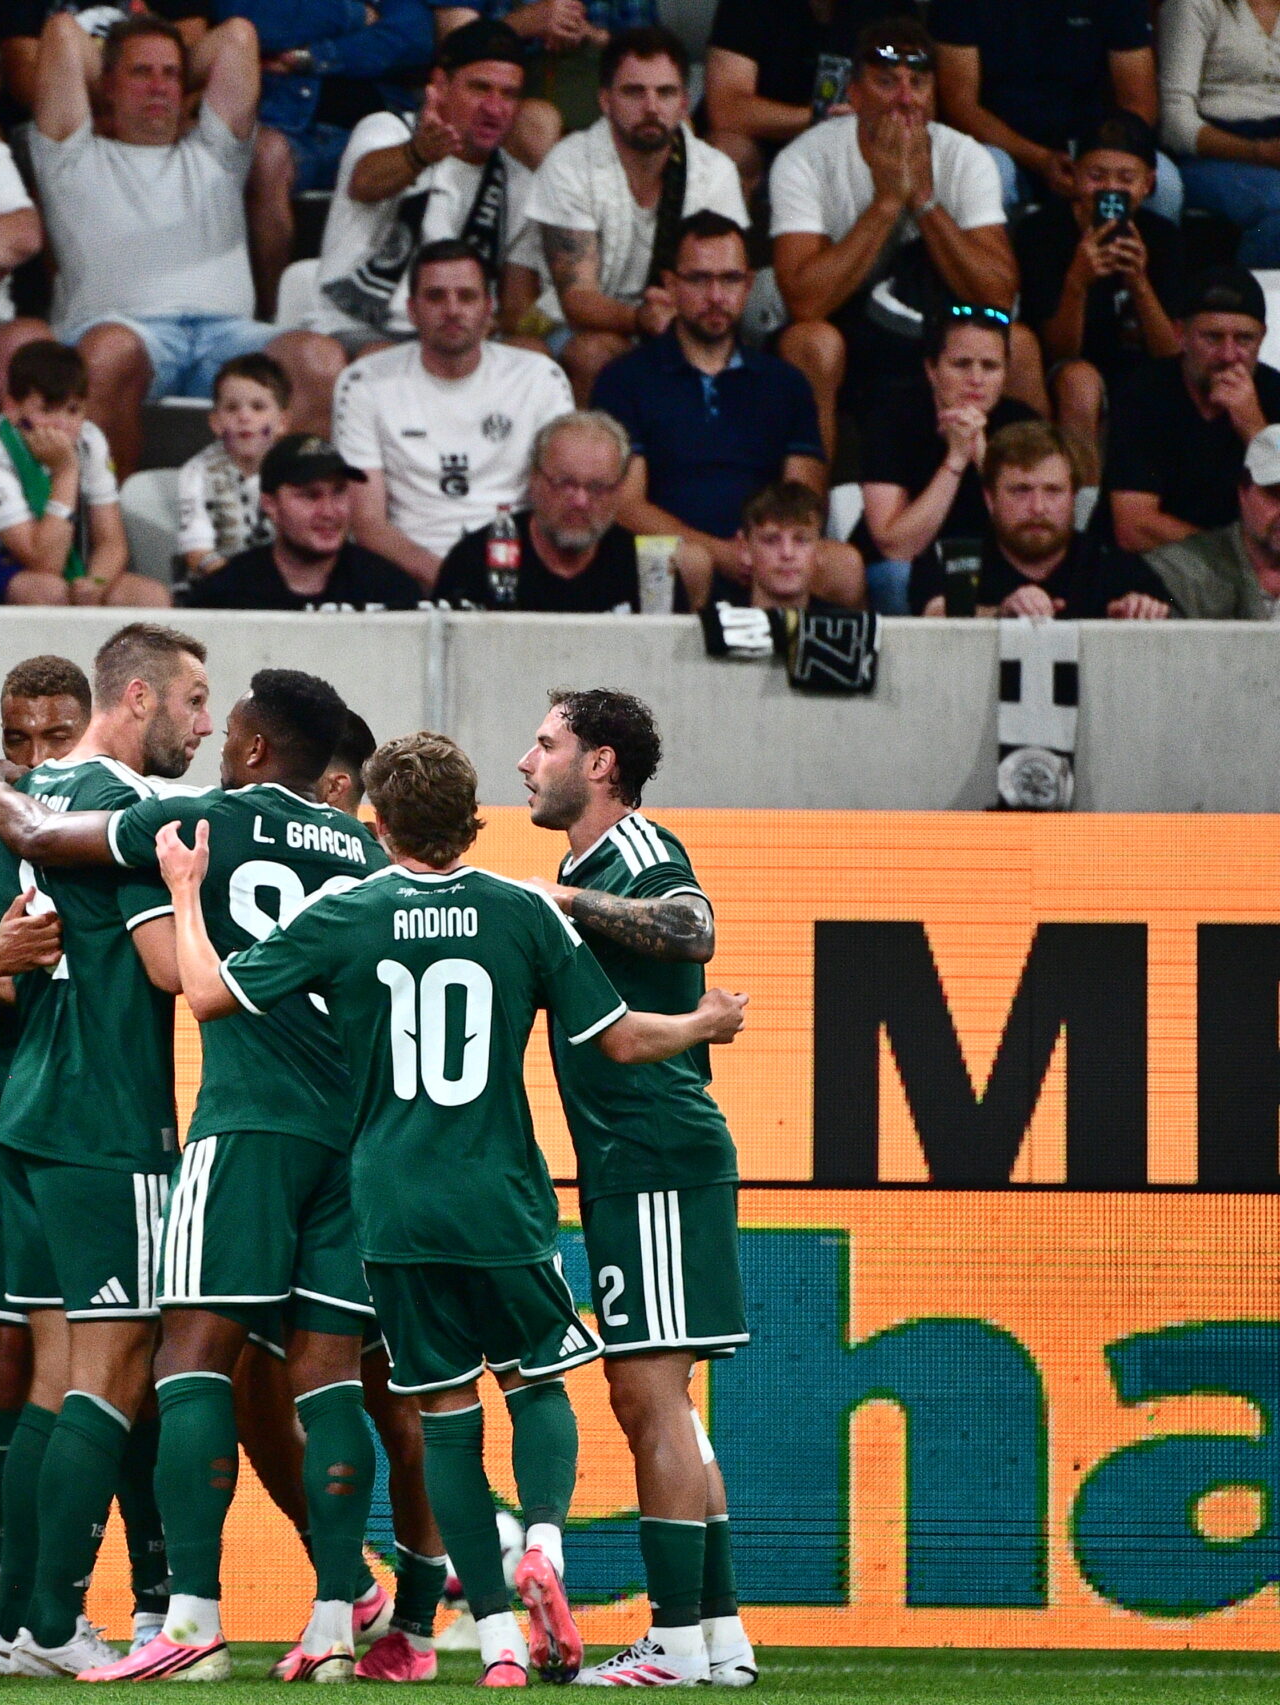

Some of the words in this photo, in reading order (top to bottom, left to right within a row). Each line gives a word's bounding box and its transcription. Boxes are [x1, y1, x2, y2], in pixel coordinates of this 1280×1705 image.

[286, 821, 366, 864] GARCIA
[394, 907, 478, 940] ANDINO
[376, 958, 493, 1106] 10
[598, 1265, 629, 1327] 2
